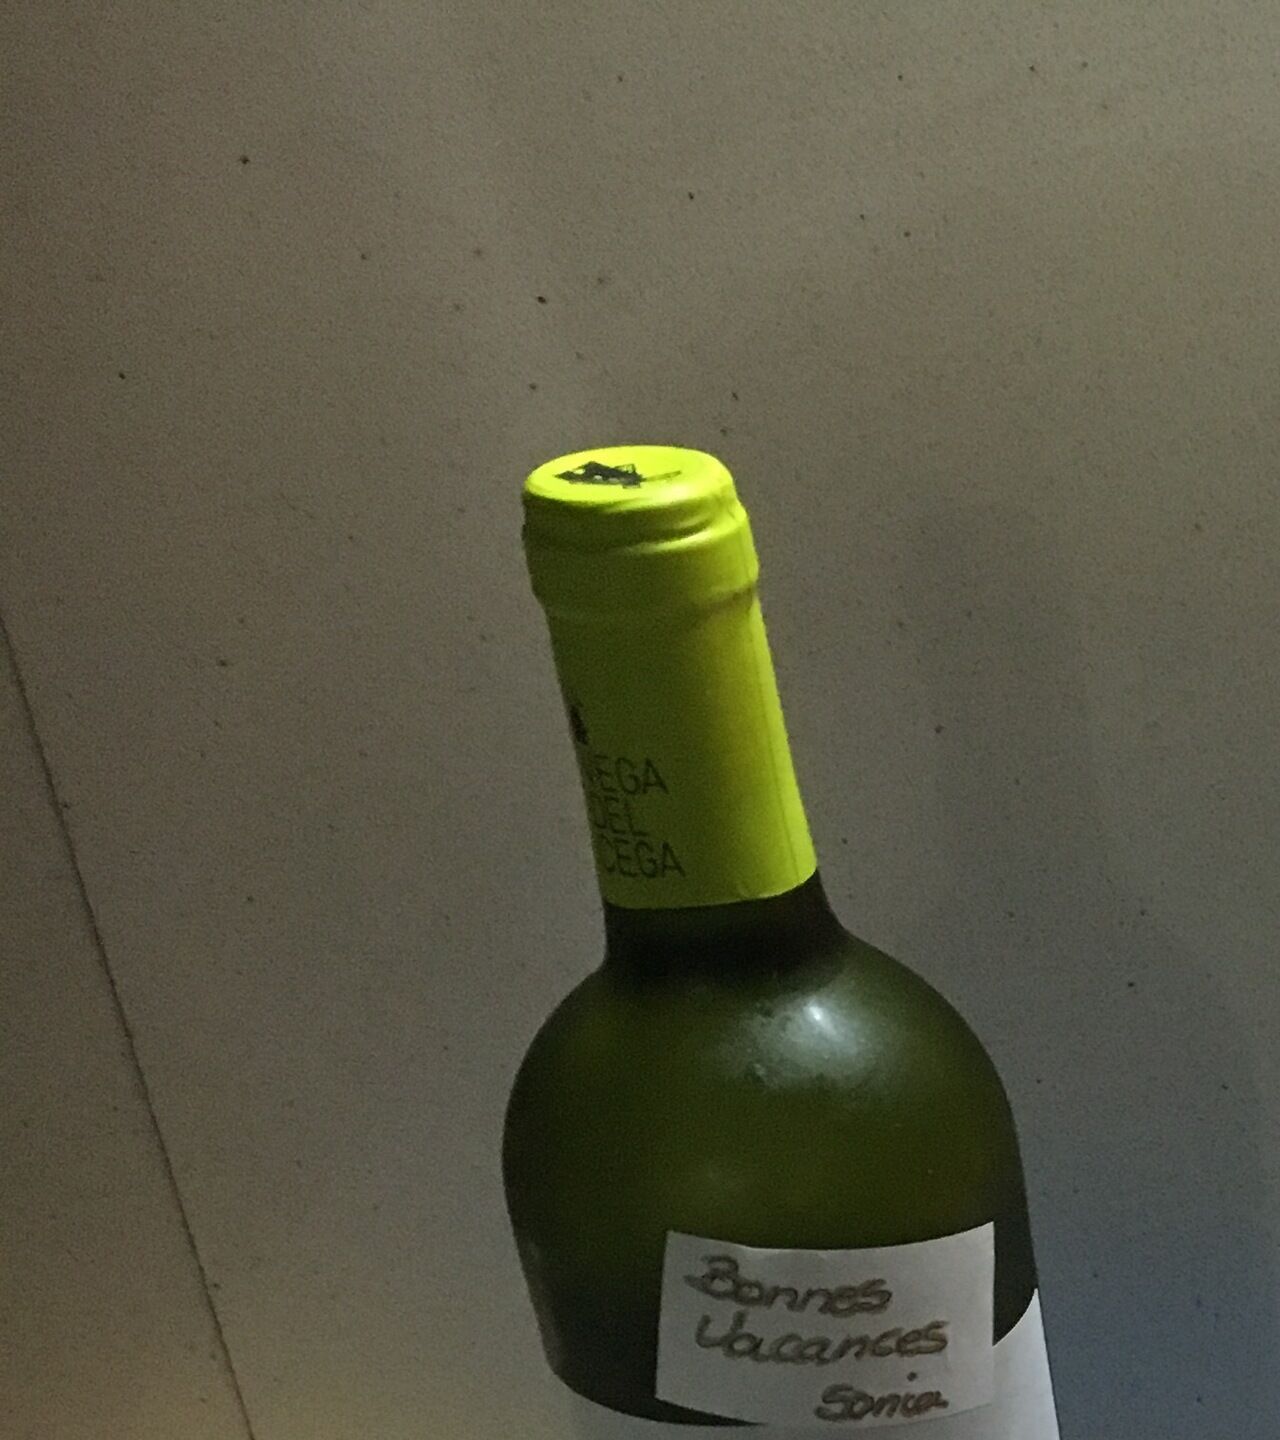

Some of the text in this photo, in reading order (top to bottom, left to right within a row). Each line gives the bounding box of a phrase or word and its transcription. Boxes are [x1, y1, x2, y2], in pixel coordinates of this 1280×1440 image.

[684, 1254, 893, 1319] Bonnes
[695, 1309, 950, 1366] Vacances
[814, 1371, 950, 1424] Sonia
